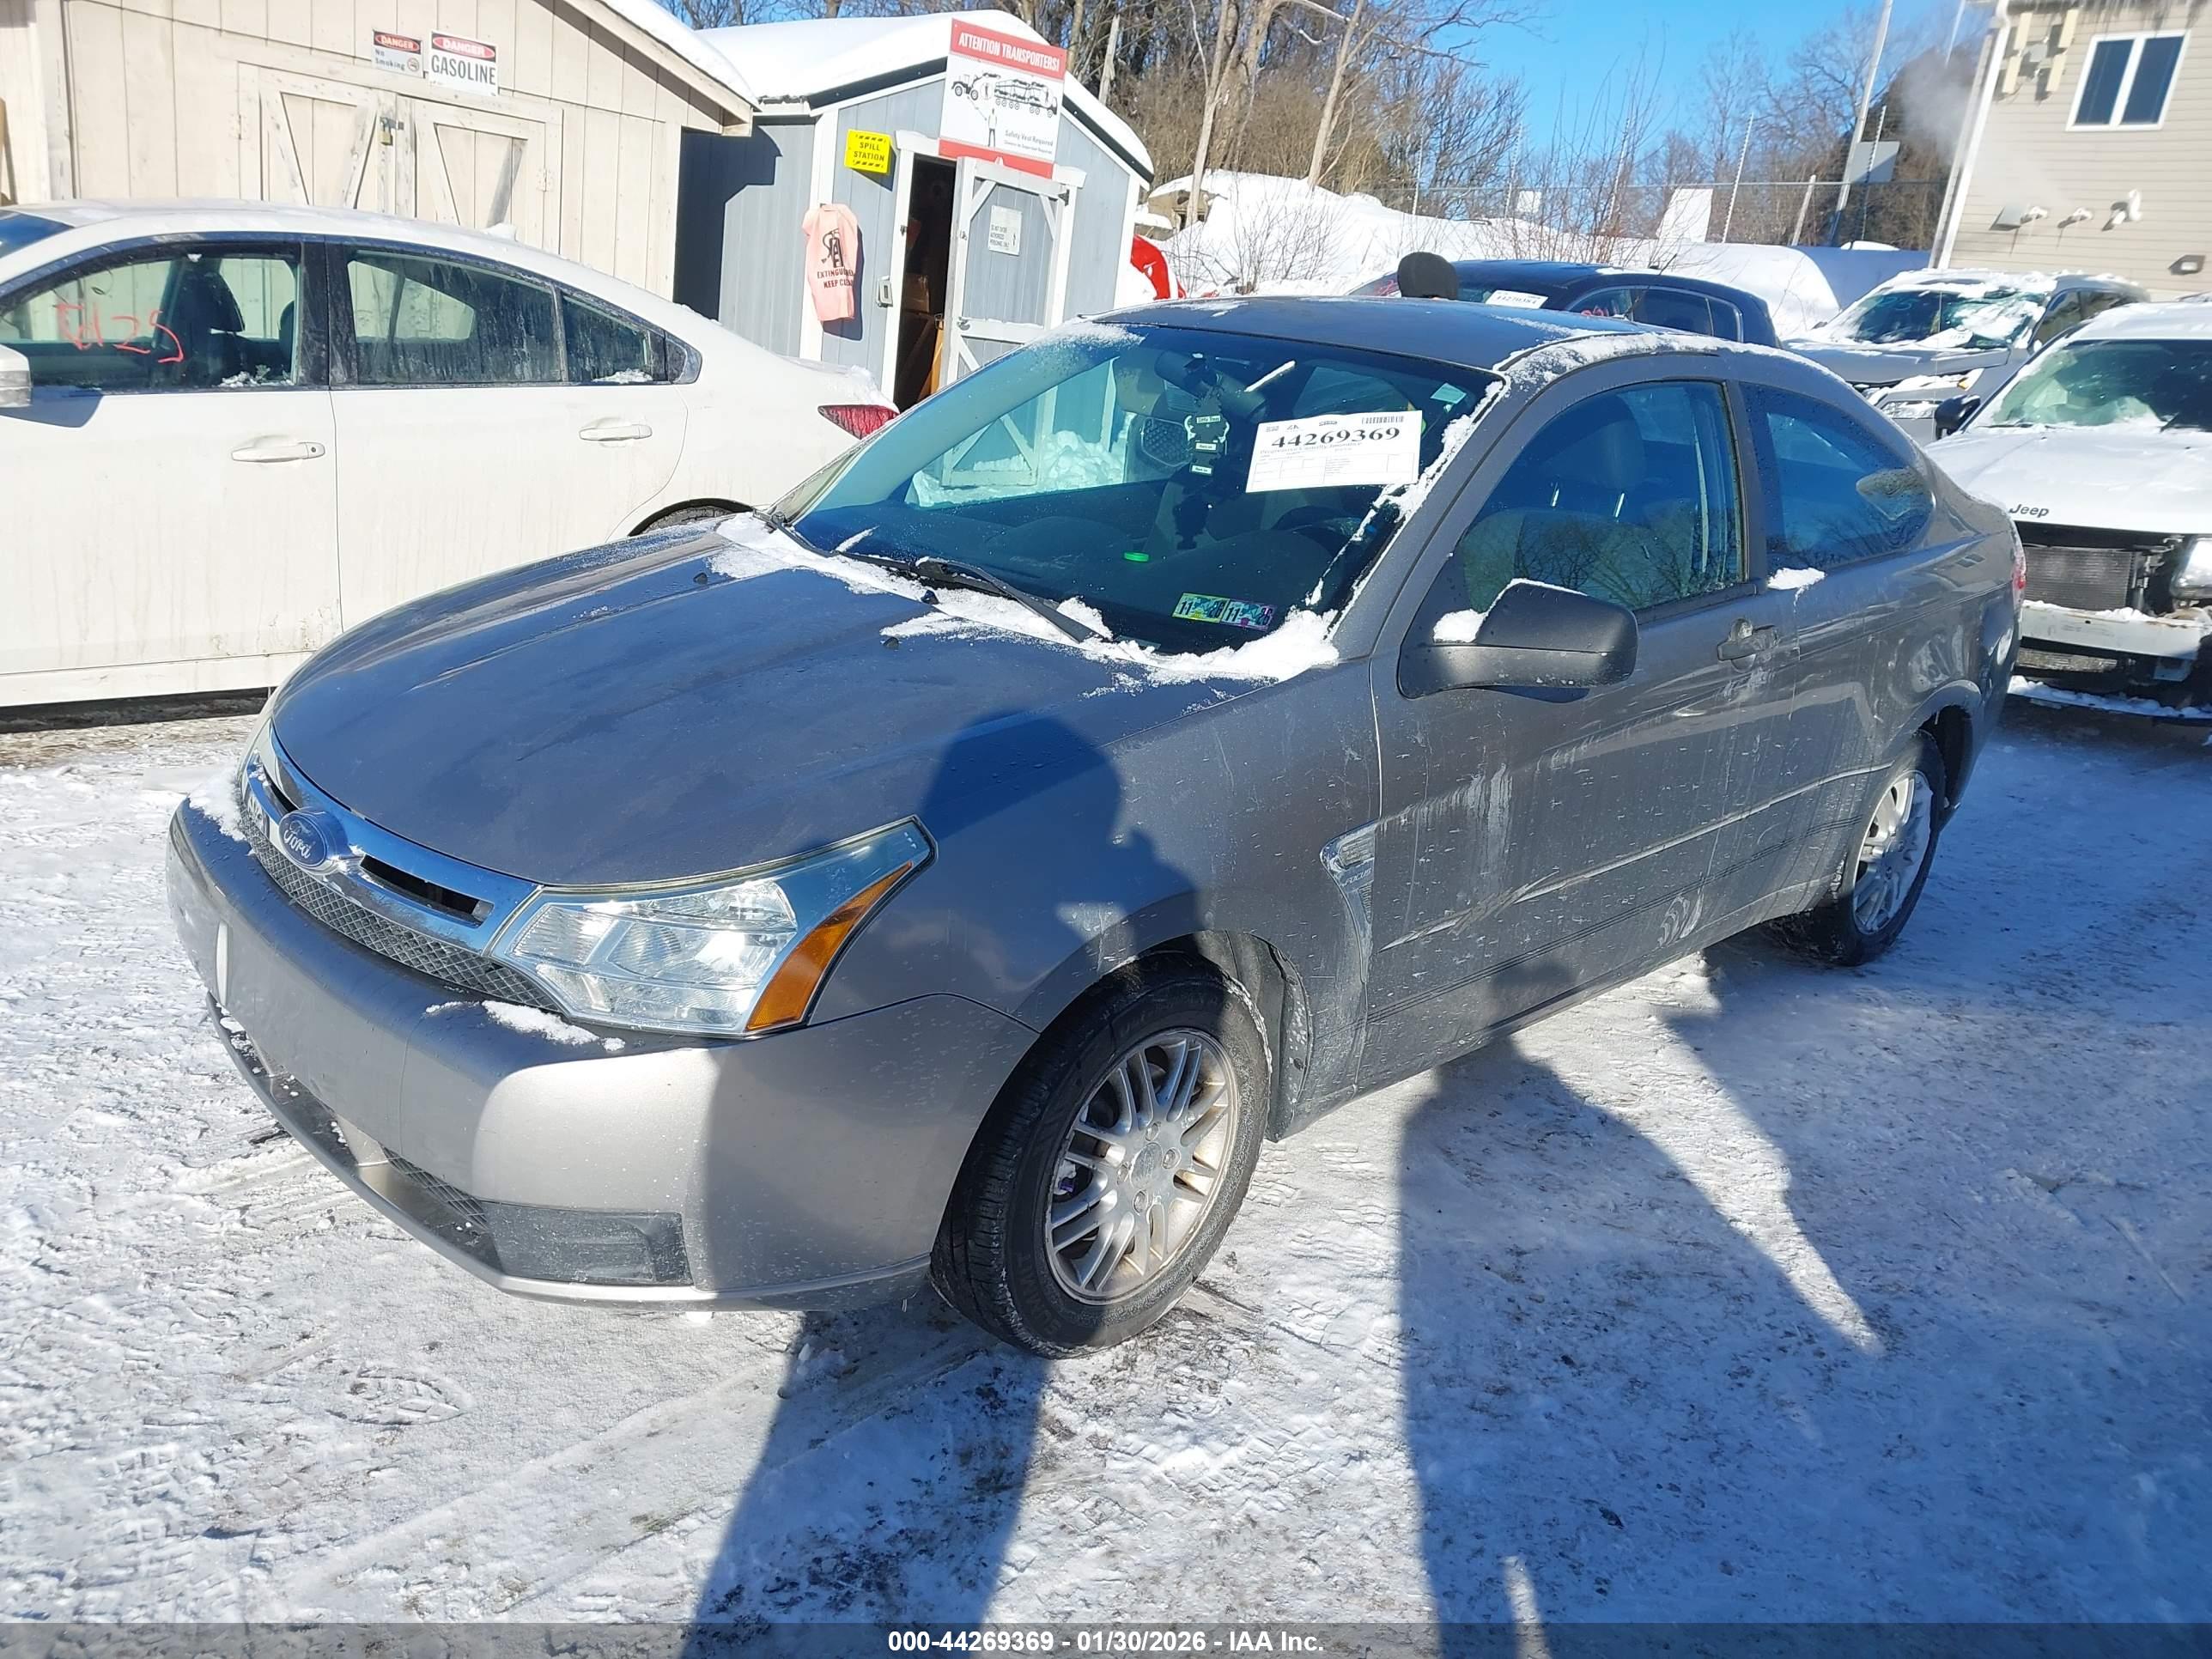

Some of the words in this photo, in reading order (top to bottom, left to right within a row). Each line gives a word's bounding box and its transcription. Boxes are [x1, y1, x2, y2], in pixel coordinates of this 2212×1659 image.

[380, 34, 414, 50] DANGER
[442, 39, 485, 56] DANGER
[375, 48, 385, 57] No
[958, 32, 1000, 56] ATTENTION
[1002, 43, 1060, 72] TRANSPORTERS!
[375, 57, 405, 70] Smoking
[431, 54, 496, 85] GASOLINE
[860, 142, 880, 151] SPILL
[854, 150, 885, 162] STATION
[823, 279, 838, 289] KEEP
[1271, 427, 1400, 448] 44269369
[2008, 504, 2050, 518] Jeep
[1179, 601, 1193, 616] 11
[1225, 606, 1240, 622] 11
[283, 820, 314, 859] Ford
